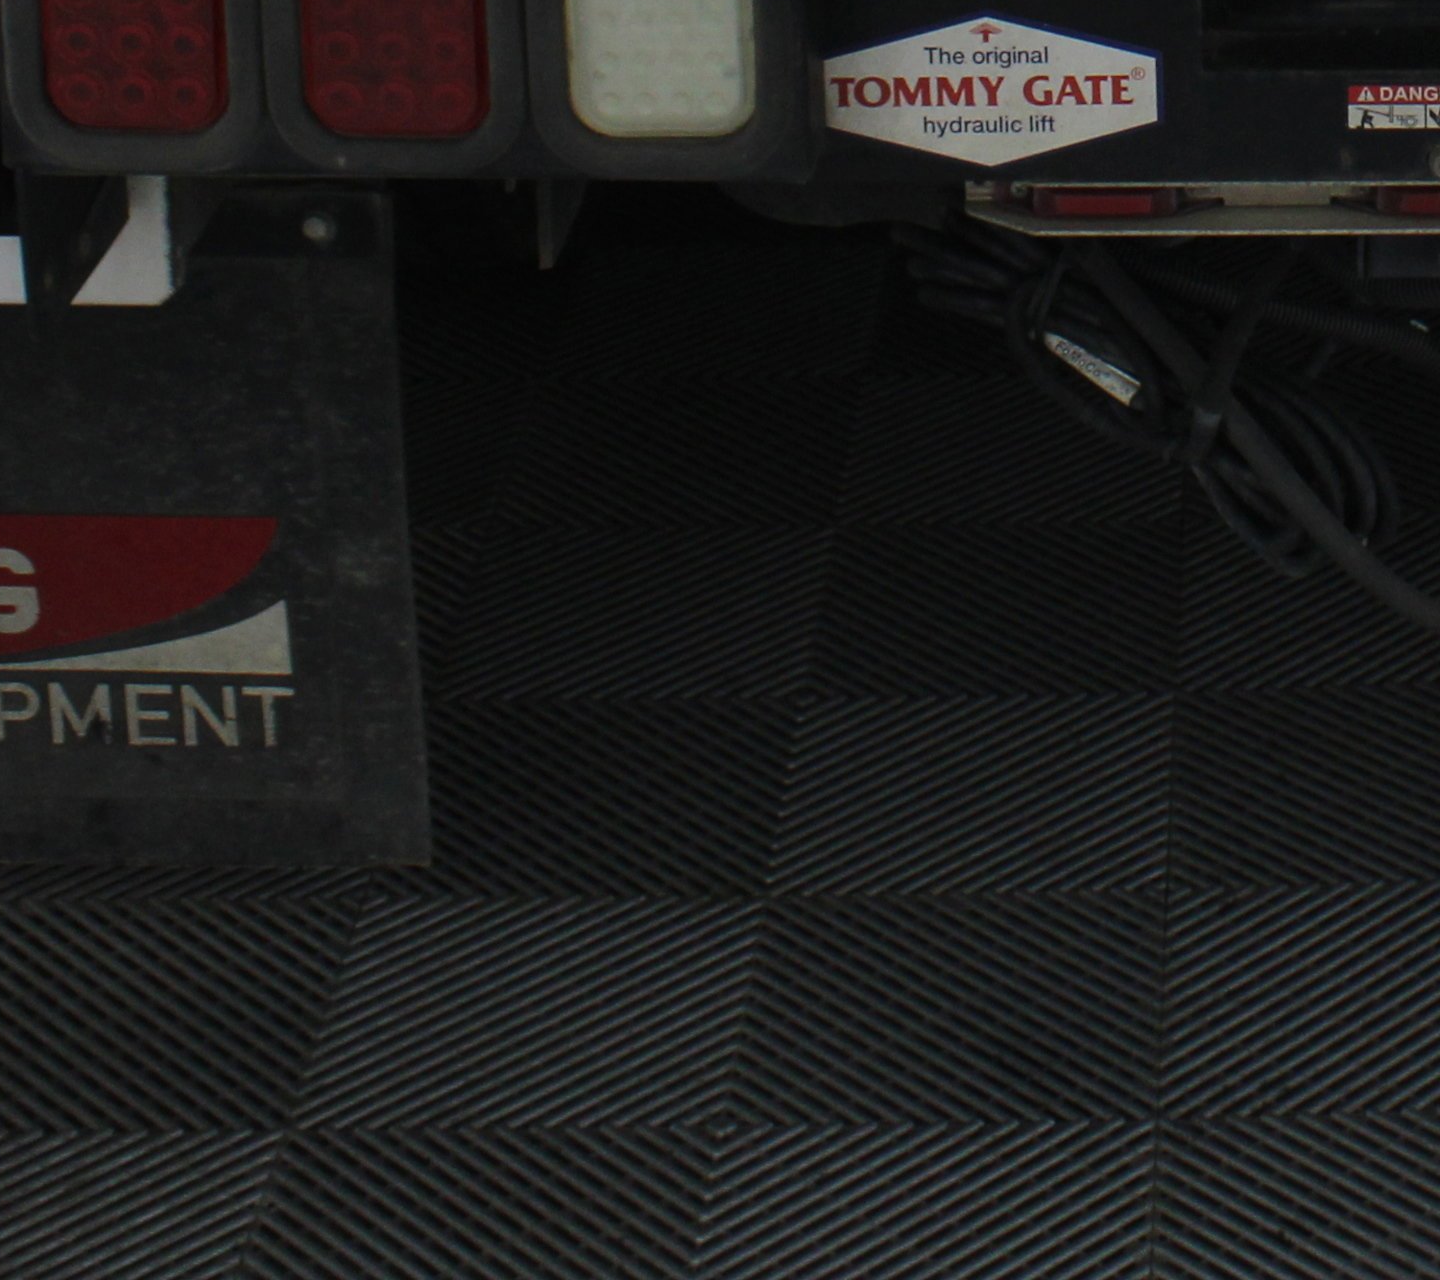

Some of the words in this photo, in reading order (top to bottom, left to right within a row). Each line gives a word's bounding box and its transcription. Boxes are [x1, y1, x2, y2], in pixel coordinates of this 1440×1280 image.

[923, 46, 965, 65] The
[972, 46, 1049, 69] original
[830, 76, 1005, 108] TOMMY
[923, 116, 1023, 138] hydraulic
[1029, 115, 1056, 134] lift
